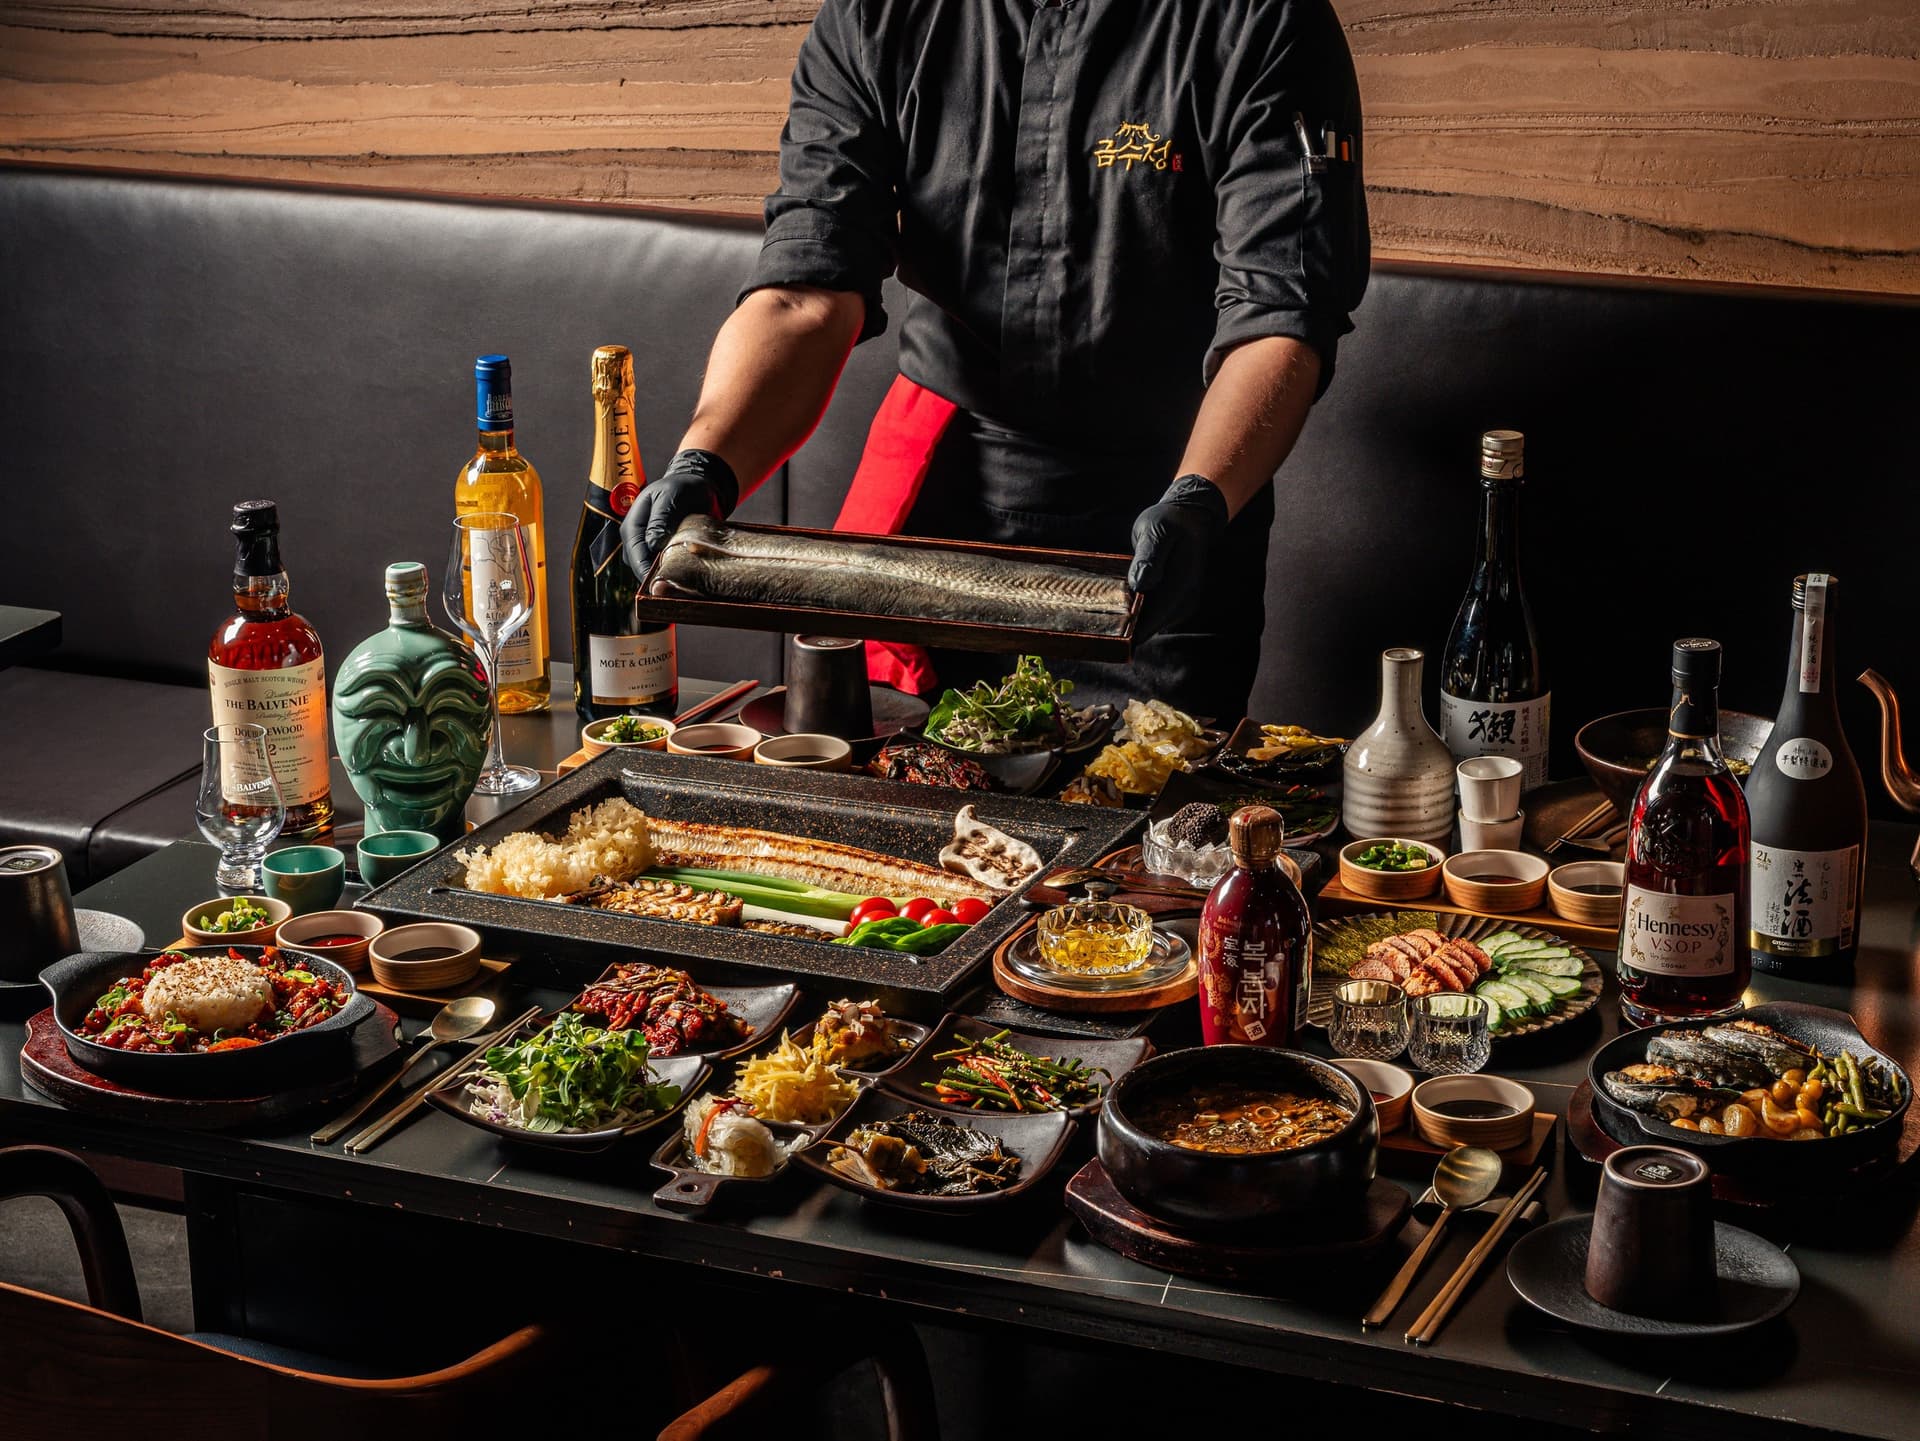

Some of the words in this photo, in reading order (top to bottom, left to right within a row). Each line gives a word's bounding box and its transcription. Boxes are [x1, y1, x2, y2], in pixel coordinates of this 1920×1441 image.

[599, 657, 625, 668] MOËT
[243, 676, 260, 684] MALT
[225, 699, 245, 710] THE
[246, 694, 310, 711] BALVENIE
[1637, 911, 1718, 940] Hennessy
[1651, 937, 1702, 954] V.S.O.P
